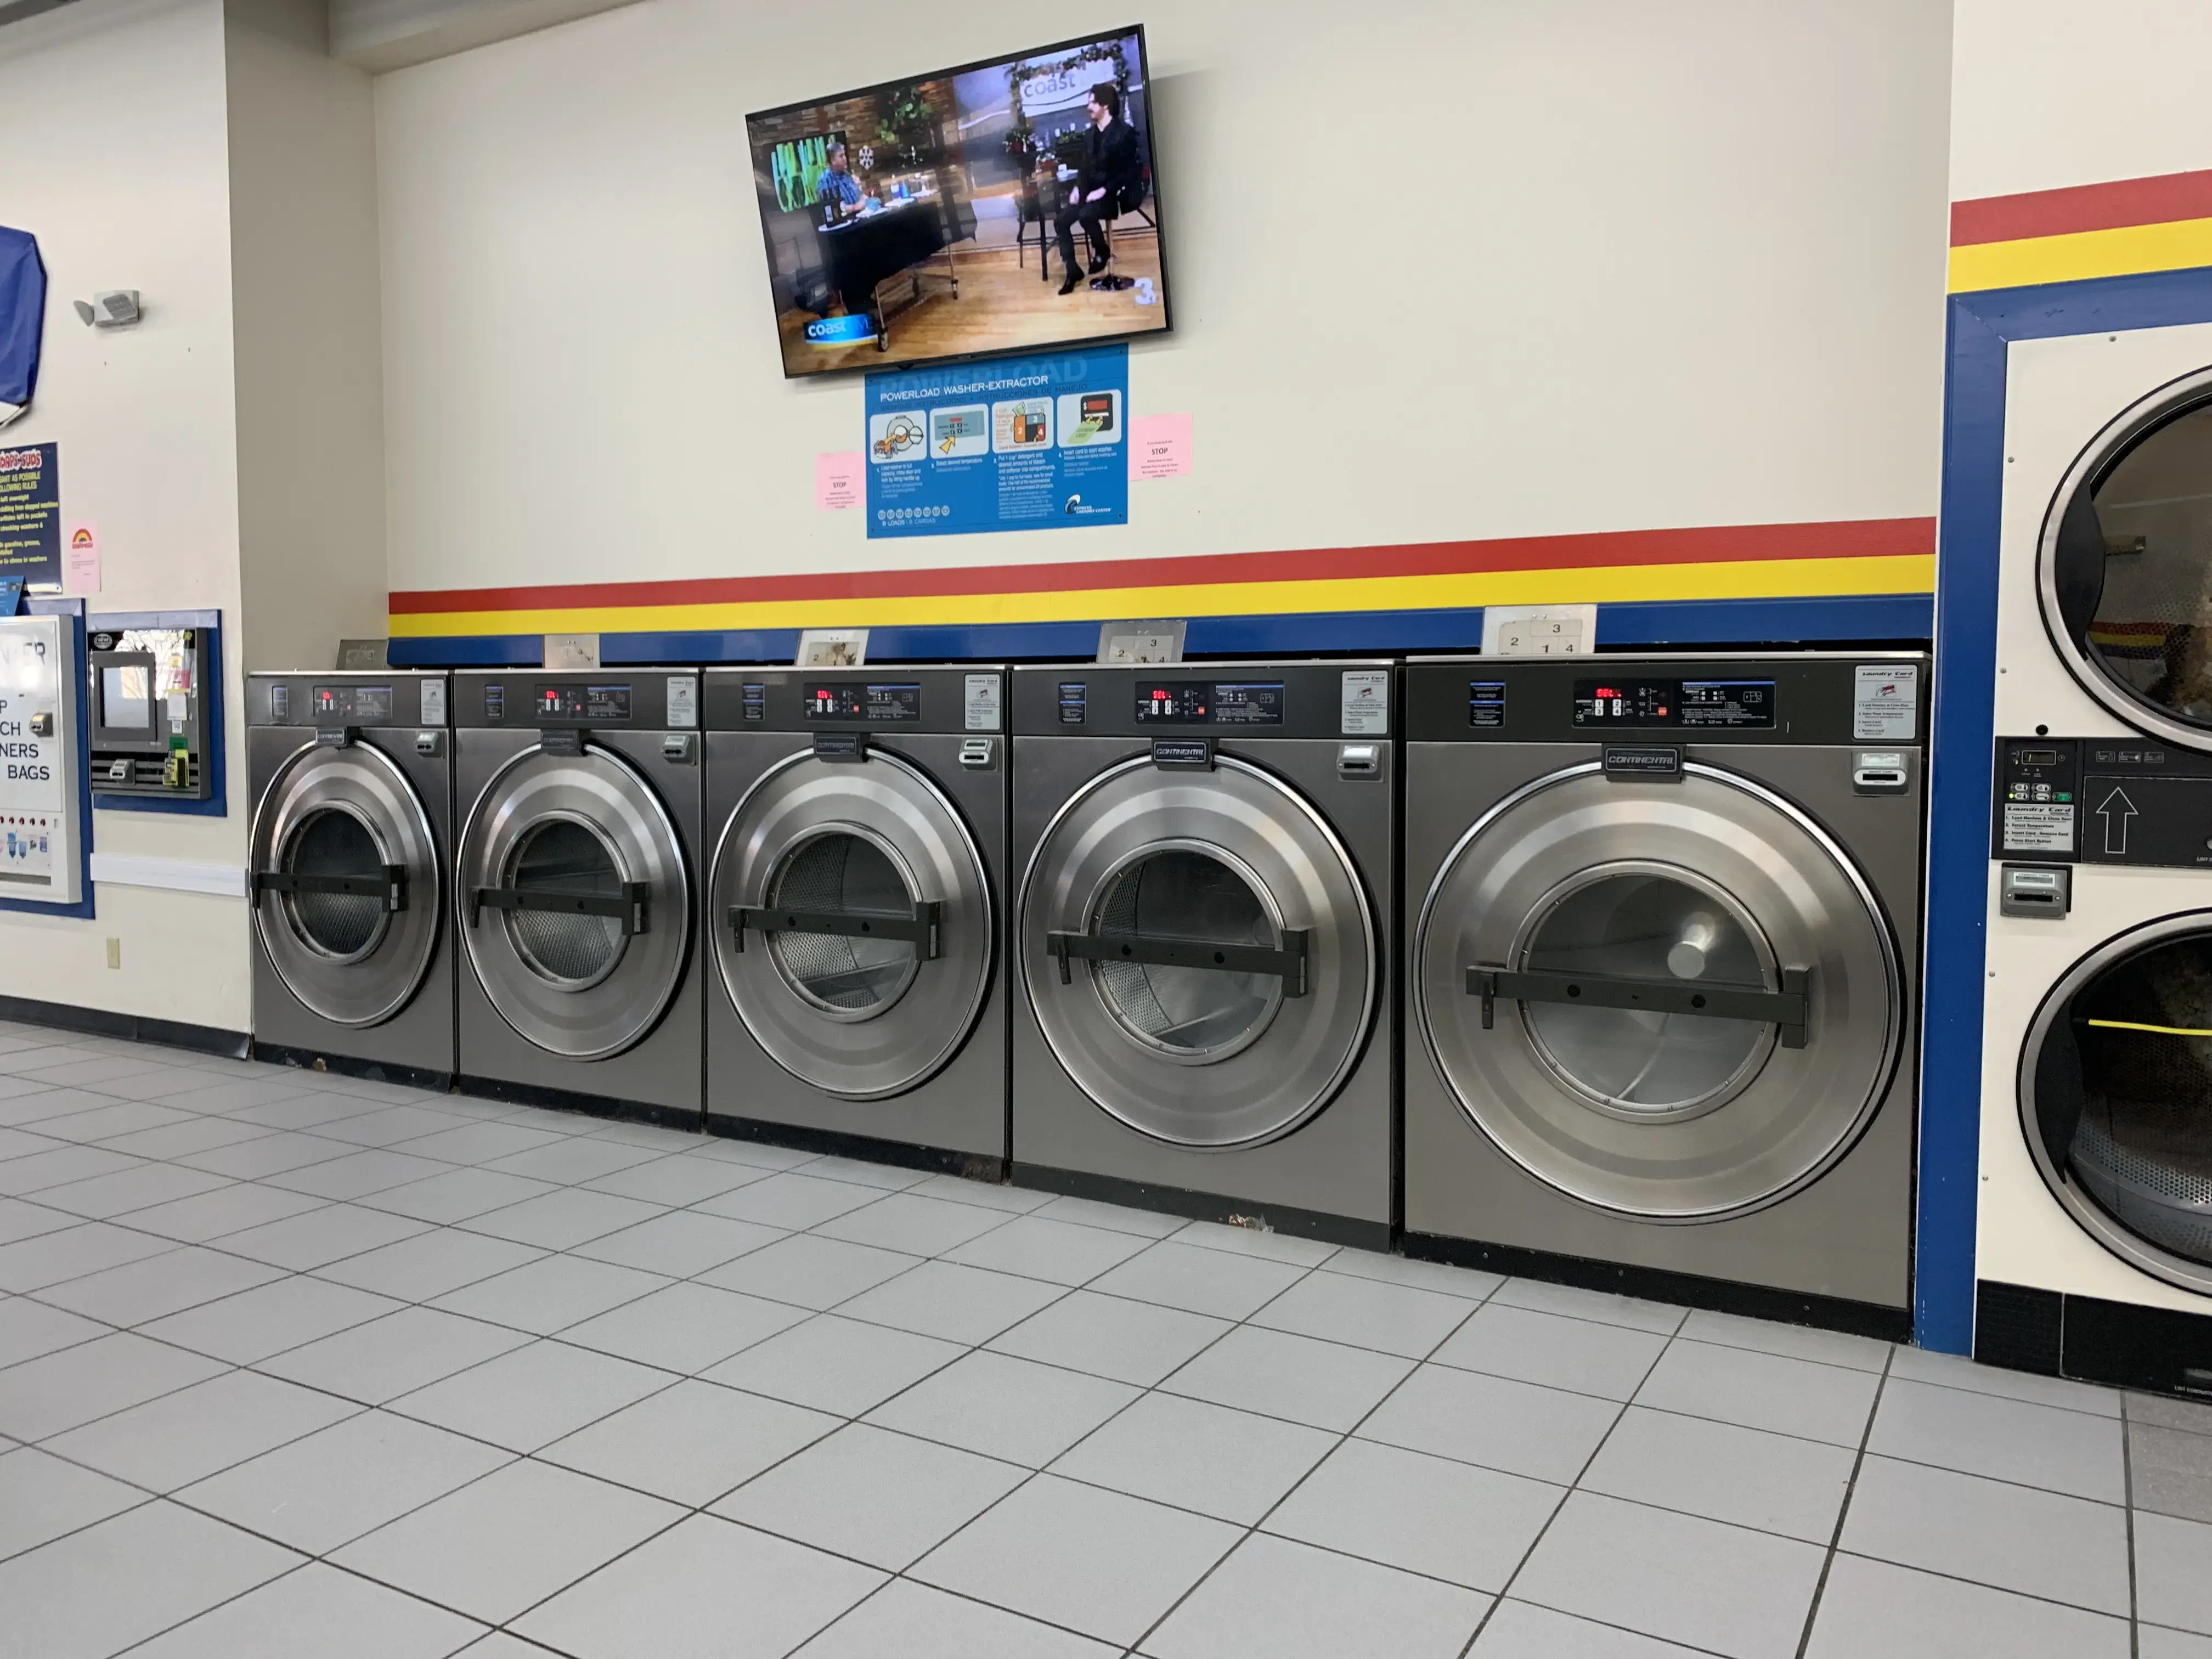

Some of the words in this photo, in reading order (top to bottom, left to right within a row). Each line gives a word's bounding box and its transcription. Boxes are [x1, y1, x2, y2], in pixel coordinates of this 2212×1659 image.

[1024, 72, 1076, 98] coast
[880, 387, 940, 402] POWERLOAD
[943, 375, 1048, 396] WASHER-EXTRACTOR
[880, 403, 912, 411] WASHING
[1041, 386, 1052, 394] DE
[1054, 383, 1087, 392] MANEJO
[1151, 447, 1168, 455] STOP
[19, 471, 41, 481] POSSIBLE
[22, 481, 37, 490] RULES
[30, 511, 48, 520] pockets
[1552, 624, 1561, 633] 3
[1150, 639, 1157, 647] 3
[1510, 636, 1519, 646] 2
[1542, 644, 1549, 653] 1
[1565, 644, 1574, 653] 4
[813, 653, 819, 662] 2
[1118, 649, 1125, 658] 2
[0, 743, 39, 759] NERS
[1608, 756, 1675, 764] CONTINENTAL
[8, 764, 50, 781] BAGS
